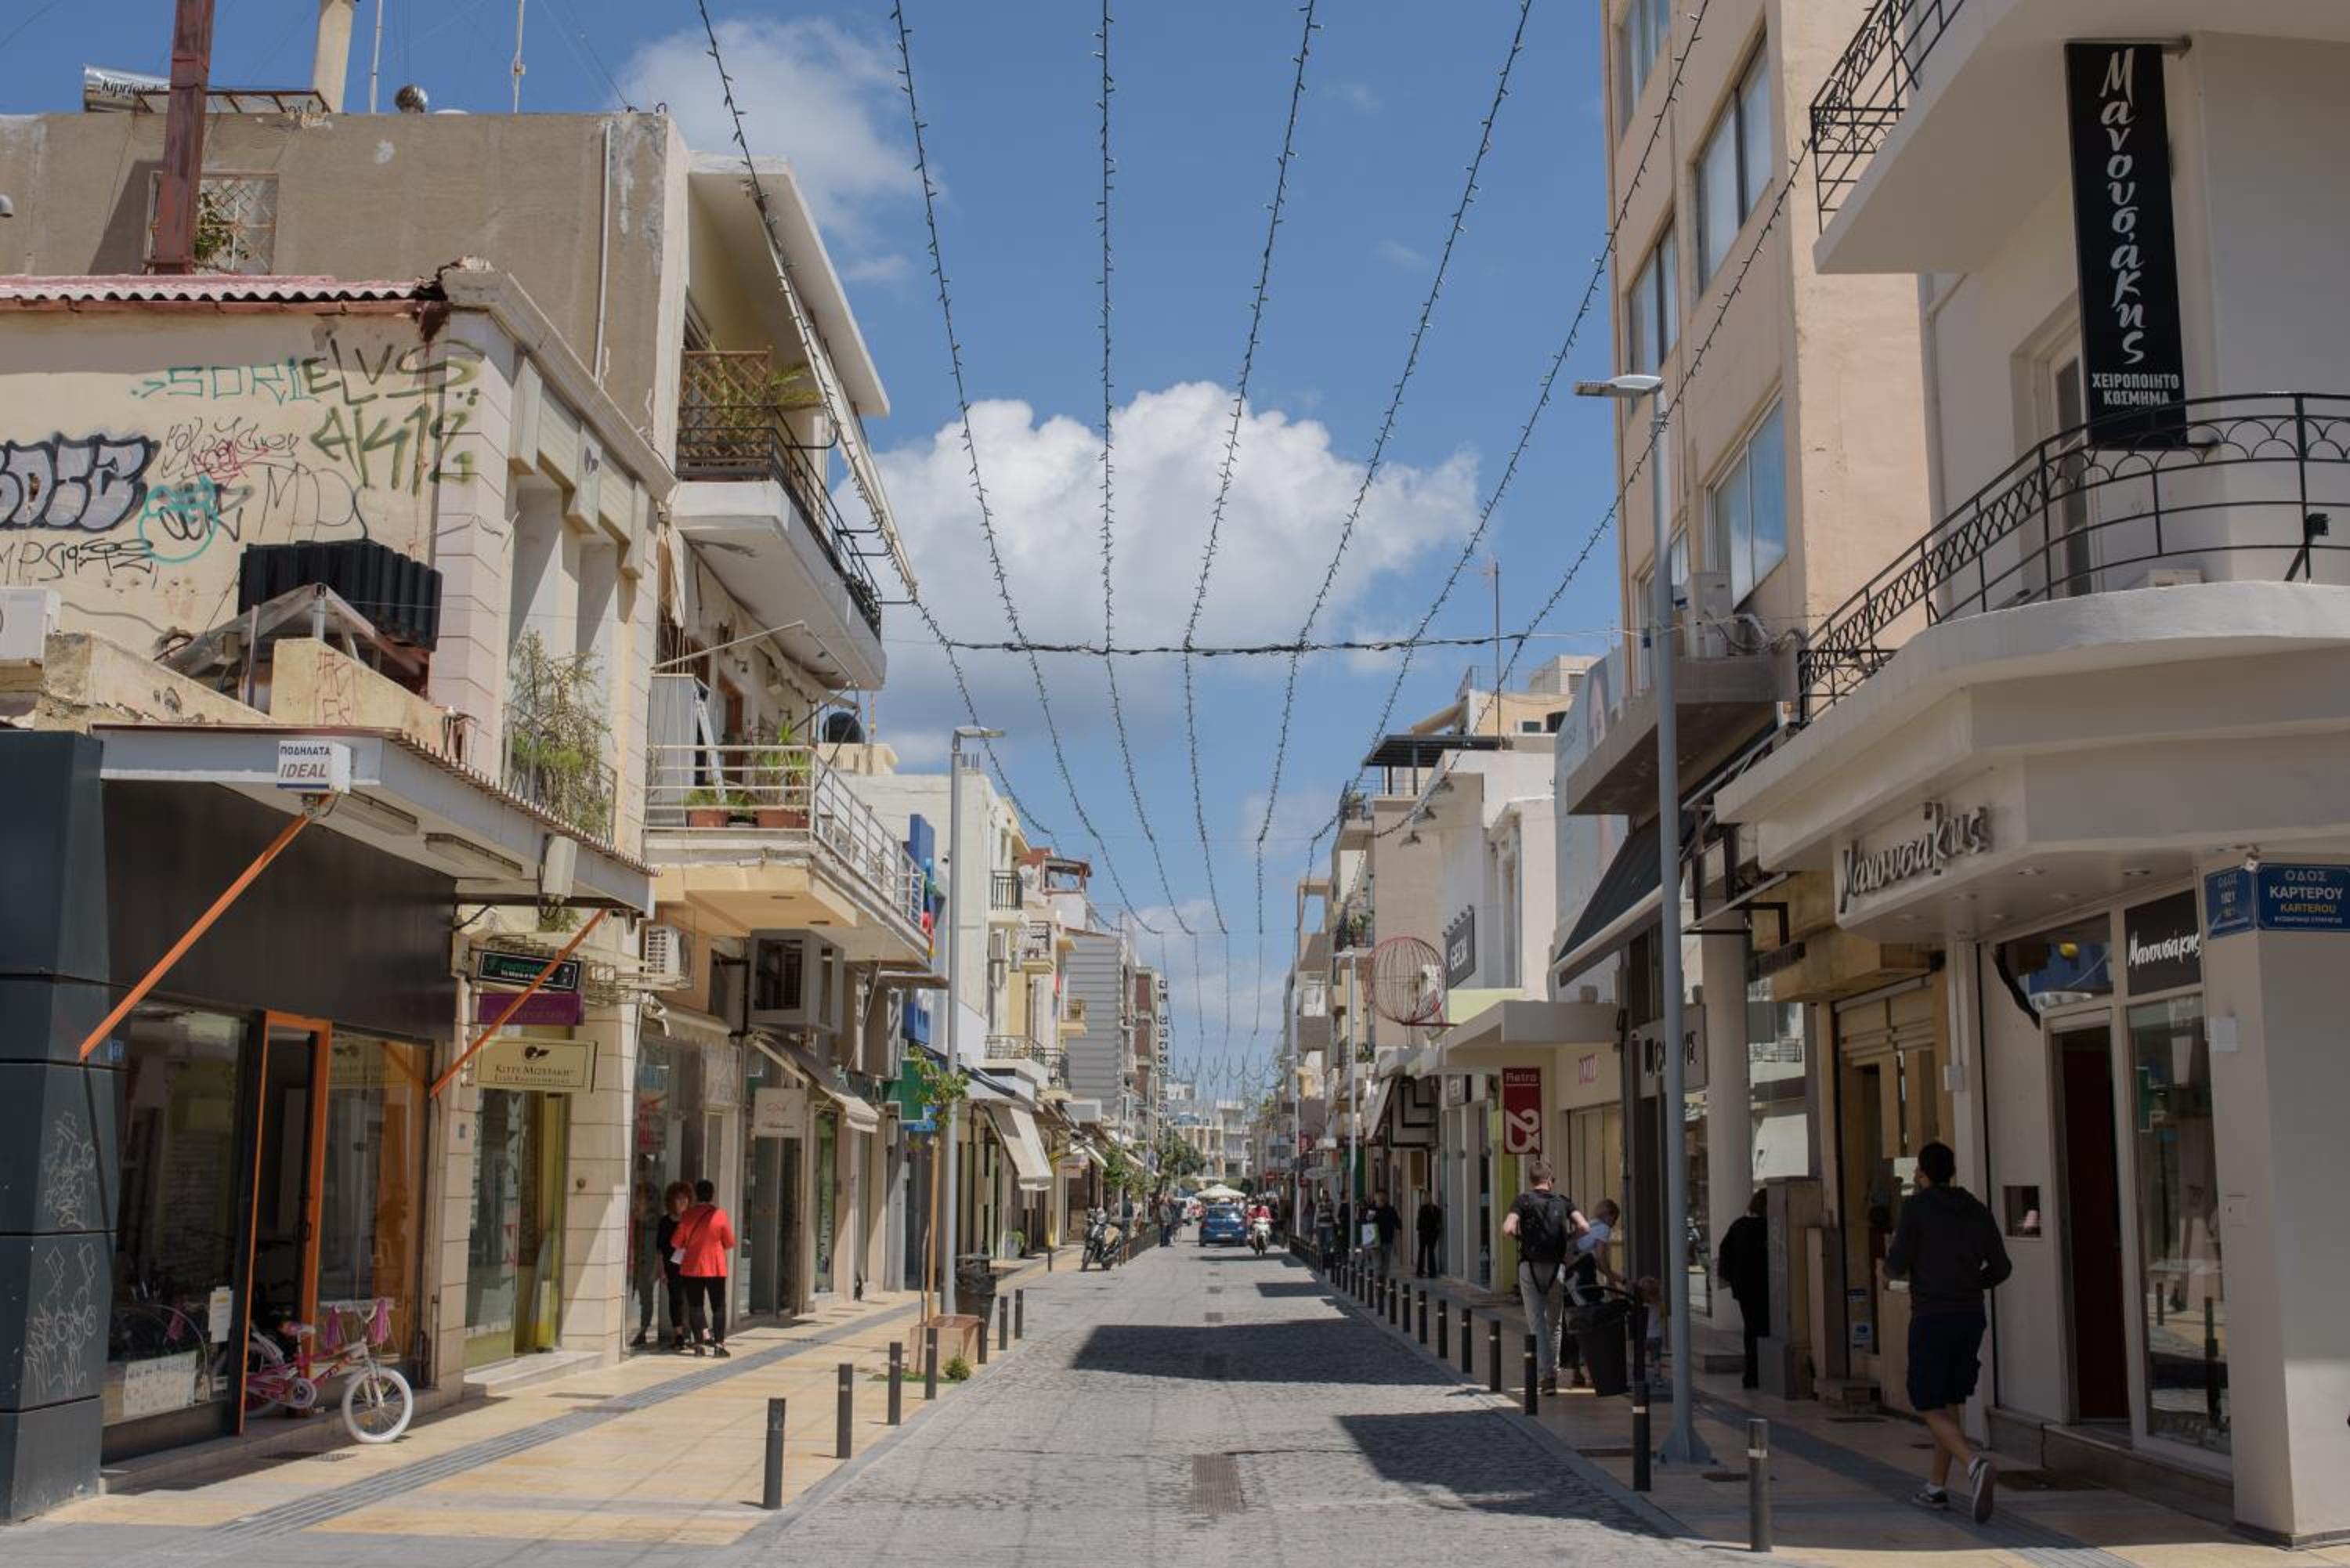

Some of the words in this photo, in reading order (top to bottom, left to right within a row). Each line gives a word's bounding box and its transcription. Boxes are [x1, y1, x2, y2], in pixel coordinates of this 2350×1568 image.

[2092, 373, 2180, 389] ΧΕΙΡΟΠΟΙΗΤΟ
[2103, 390, 2170, 406] ΚΟΣΜΗΜΑ
[280, 746, 331, 756] ΠΟΔΗΛΑΤΑ
[280, 764, 327, 778] IDEAL
[2285, 869, 2327, 882] ΟΔΟΣ
[2269, 885, 2344, 900] ΚΑΡΤΕΡΟΥ
[2280, 903, 2337, 914] KARTEROU
[1506, 1071, 1537, 1082] Retro
